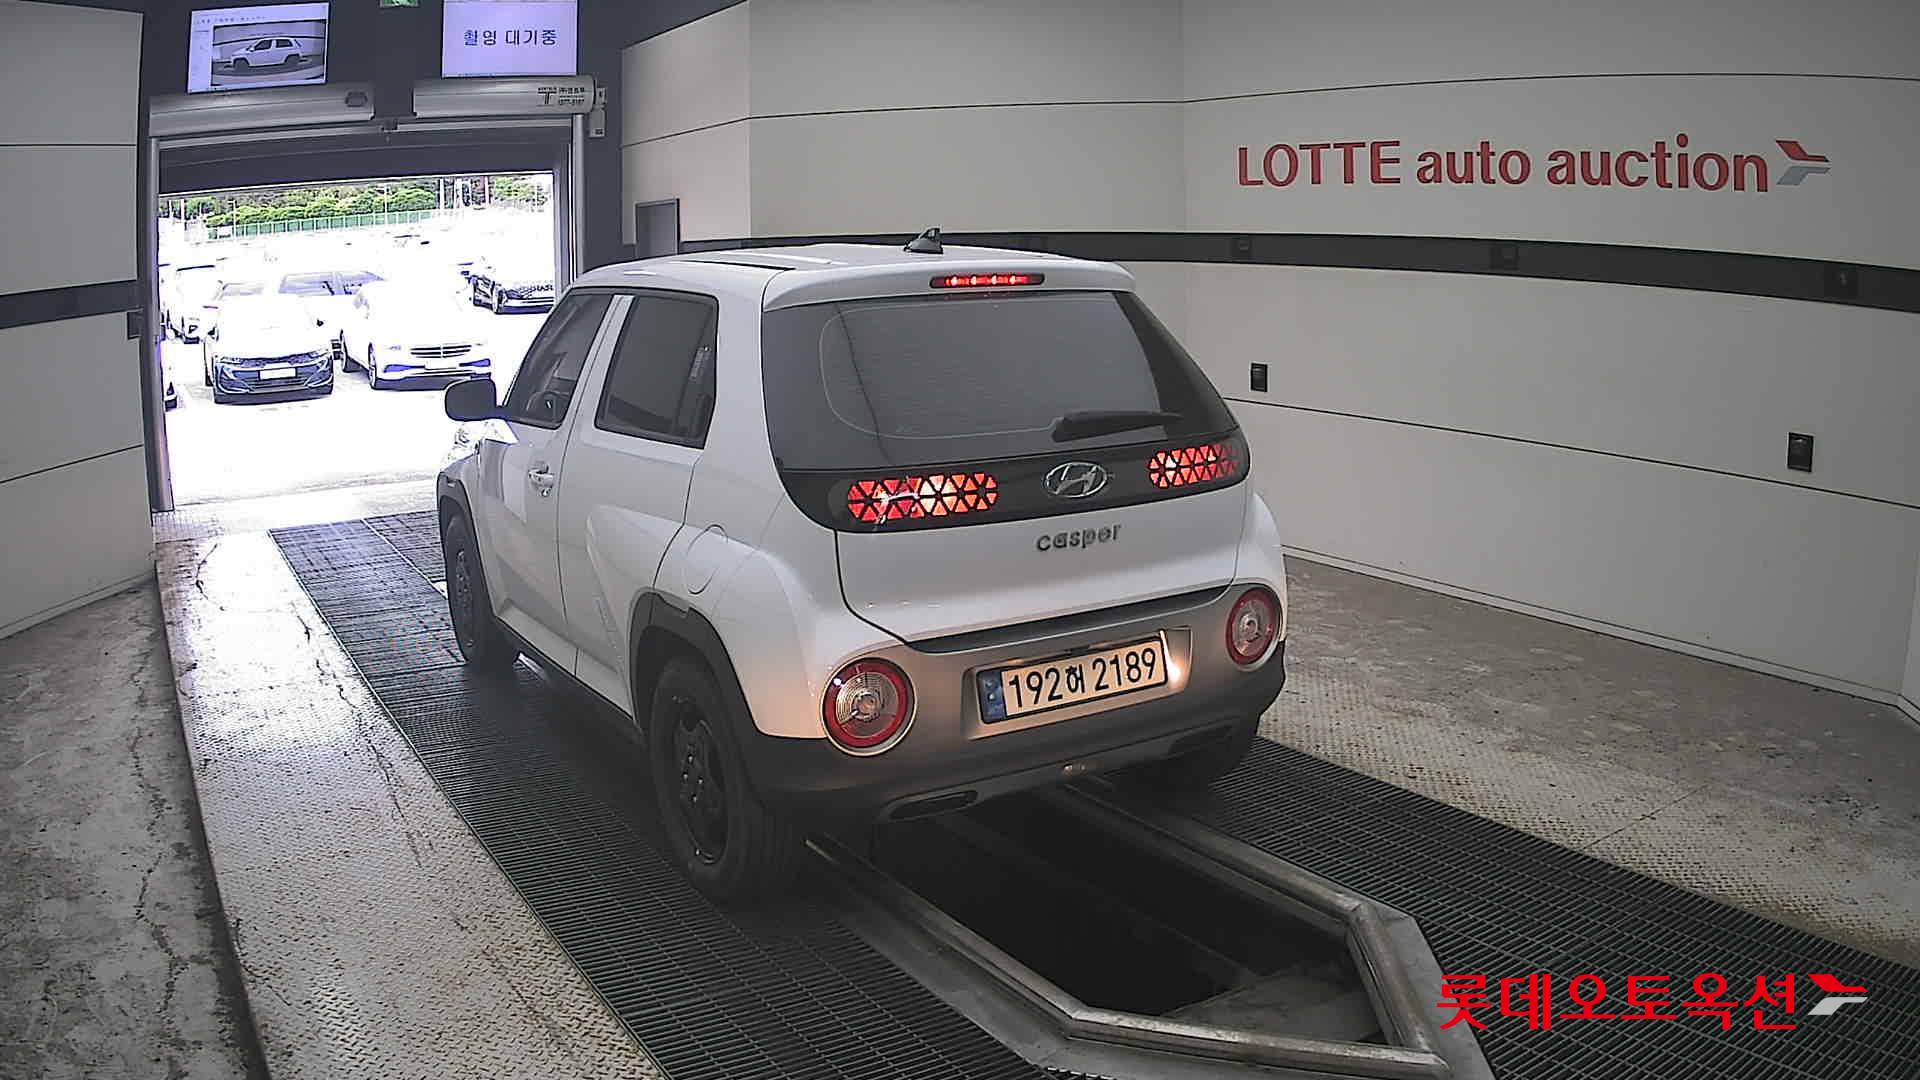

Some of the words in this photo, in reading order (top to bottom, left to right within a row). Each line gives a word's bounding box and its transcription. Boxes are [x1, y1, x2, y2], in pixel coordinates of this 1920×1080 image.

[505, 29, 557, 46] 대기중
[1238, 140, 1401, 187] LOTTE
[1416, 140, 1532, 185] auto
[1547, 132, 1768, 193] auction
[1037, 524, 1121, 551] casper
[1092, 647, 1156, 692] 2189
